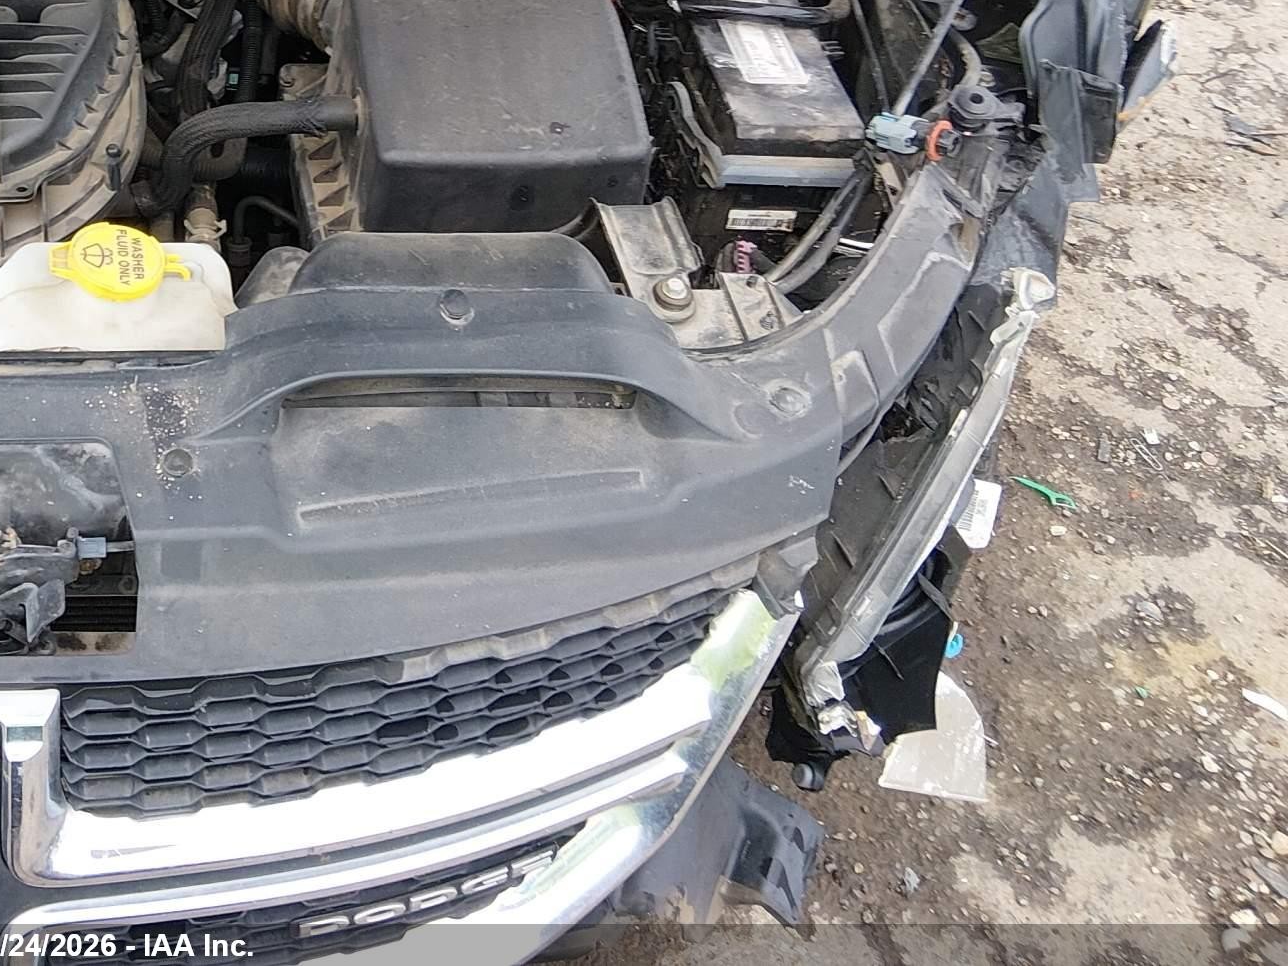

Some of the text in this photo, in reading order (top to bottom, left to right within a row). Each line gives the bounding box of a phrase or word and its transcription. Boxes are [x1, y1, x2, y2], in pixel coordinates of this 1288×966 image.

[116, 229, 131, 286] FLUID ONLY
[131, 237, 145, 280] WASHER
